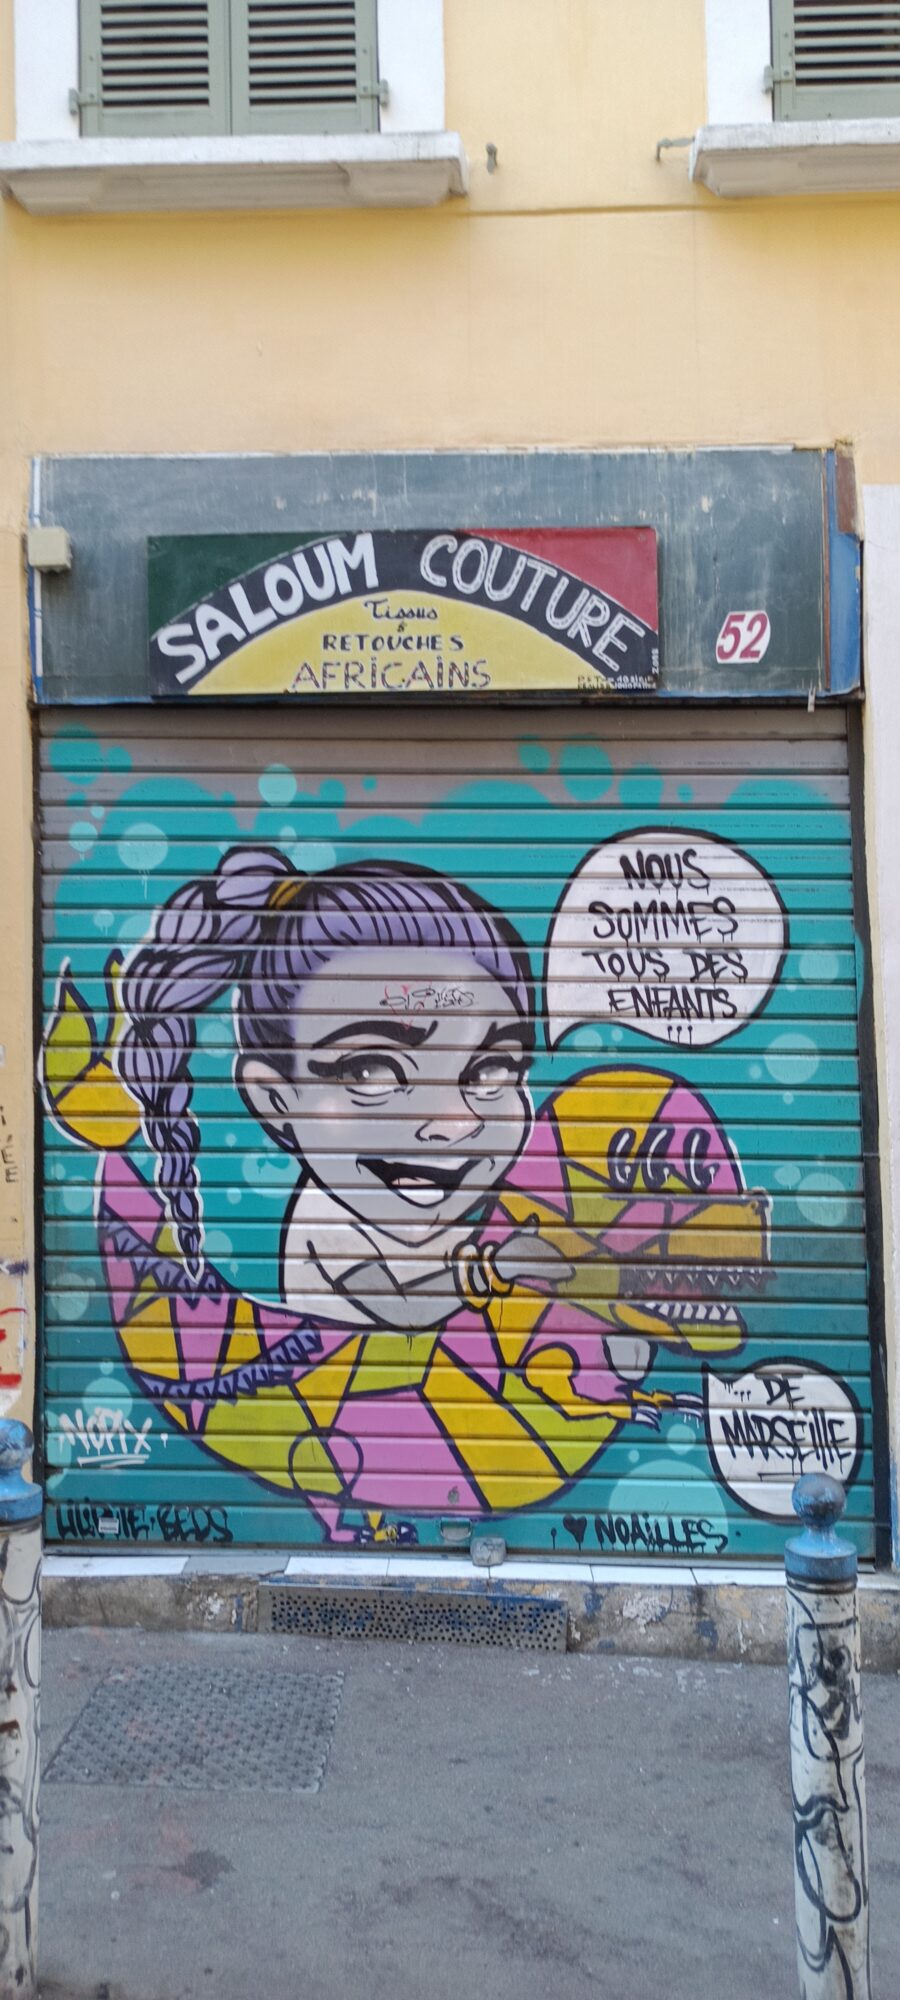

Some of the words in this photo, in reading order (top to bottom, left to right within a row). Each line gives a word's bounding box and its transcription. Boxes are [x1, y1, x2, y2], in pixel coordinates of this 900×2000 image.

[157, 532, 378, 684] SALOUM
[420, 534, 646, 672] COUTURE
[364, 598, 438, 620] Tissus
[322, 634, 464, 651] RETOUCHES
[717, 613, 768, 660] 52
[619, 848, 711, 894] NOUS
[588, 896, 738, 942] SOMMES
[682, 946, 748, 983] DES
[607, 985, 738, 1021] ENFANTS
[755, 1373, 804, 1408] DE
